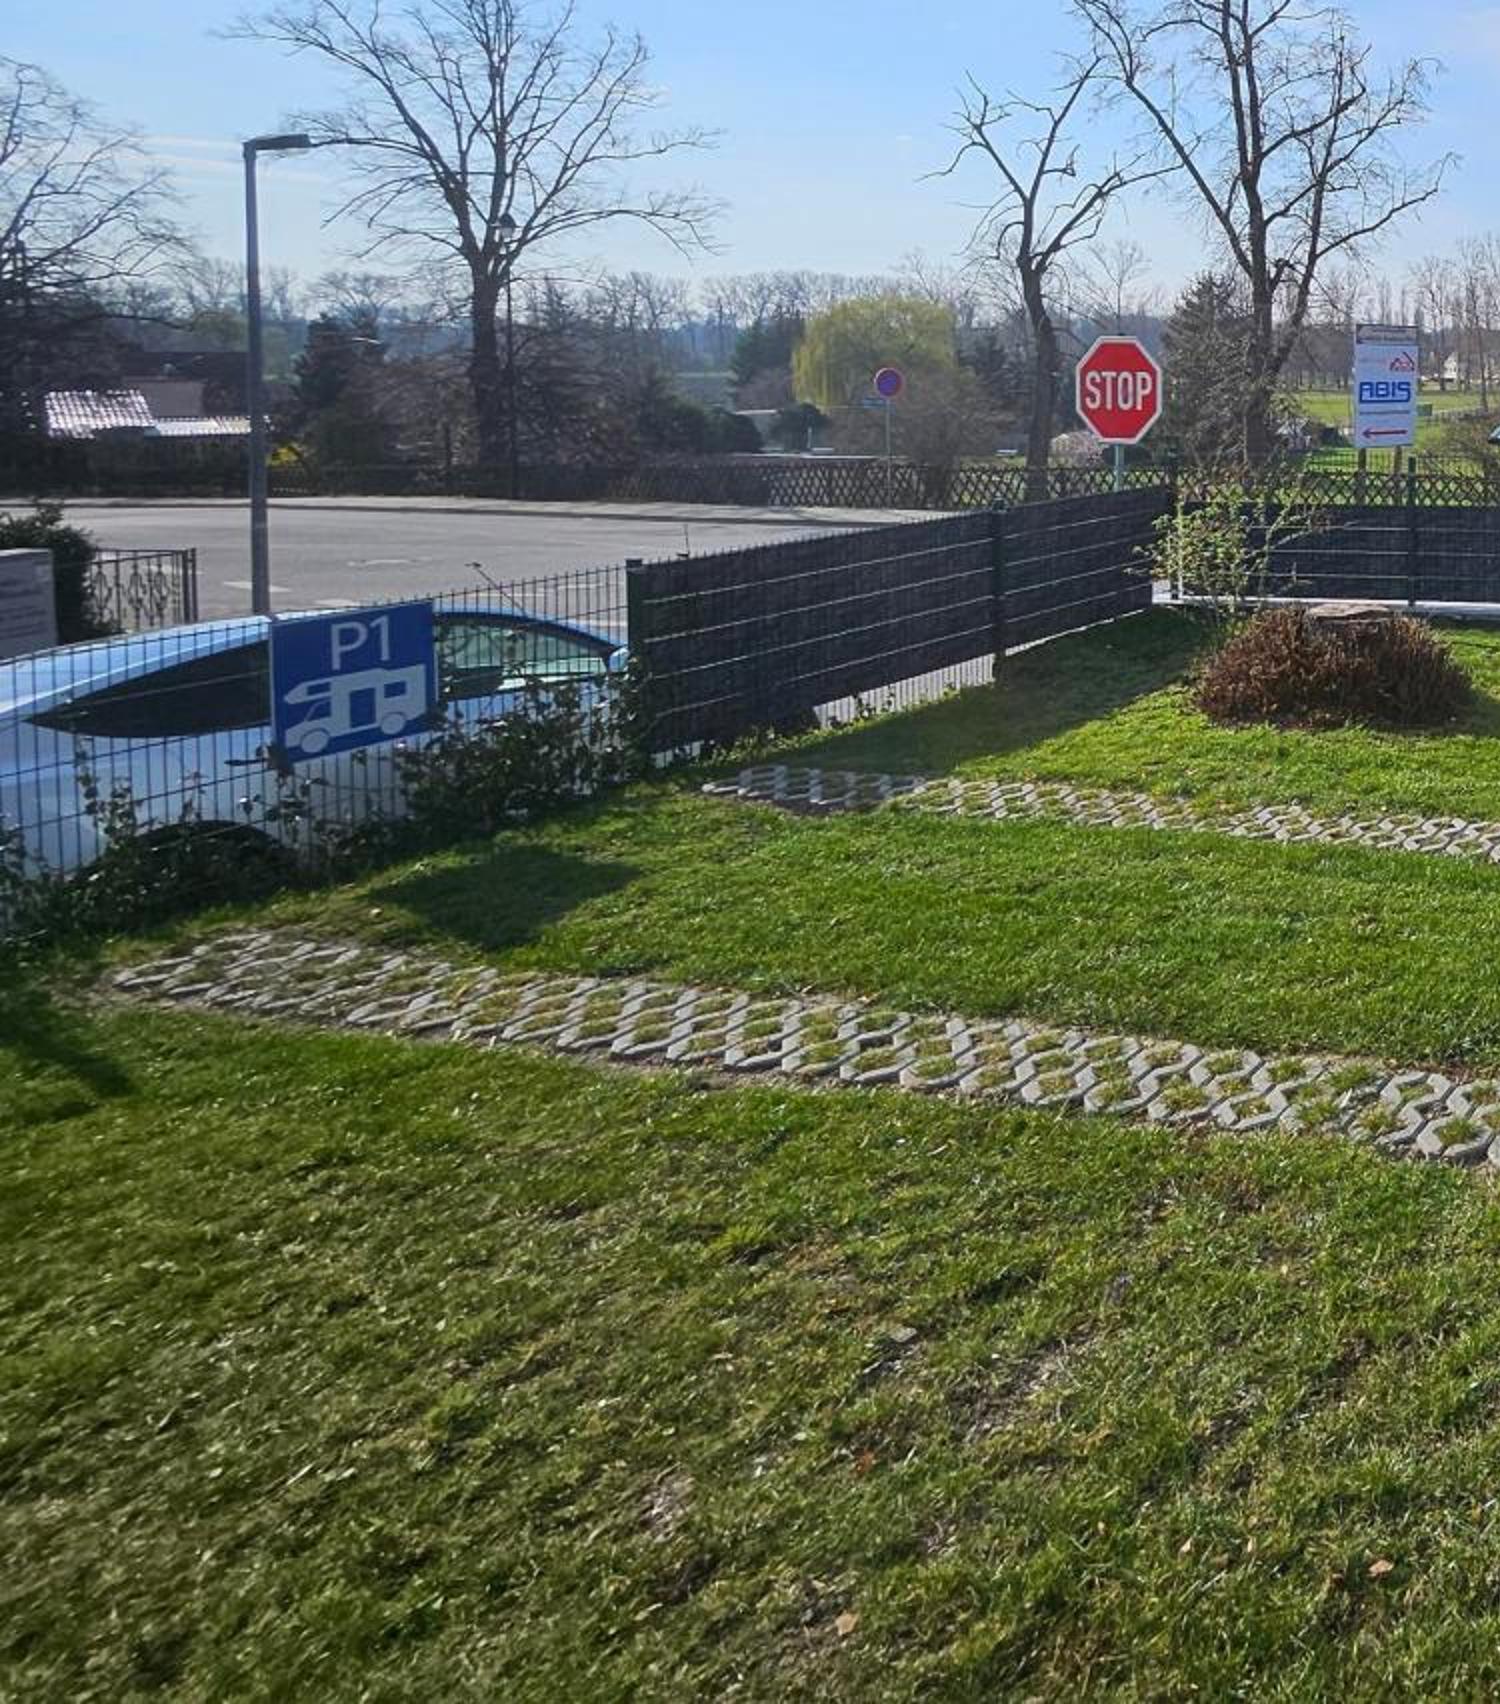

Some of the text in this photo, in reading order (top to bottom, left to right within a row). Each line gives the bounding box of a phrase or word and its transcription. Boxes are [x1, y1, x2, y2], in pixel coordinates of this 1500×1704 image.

[1085, 370, 1153, 411] STOP
[1359, 381, 1411, 403] ABIS
[331, 614, 391, 672] P1
